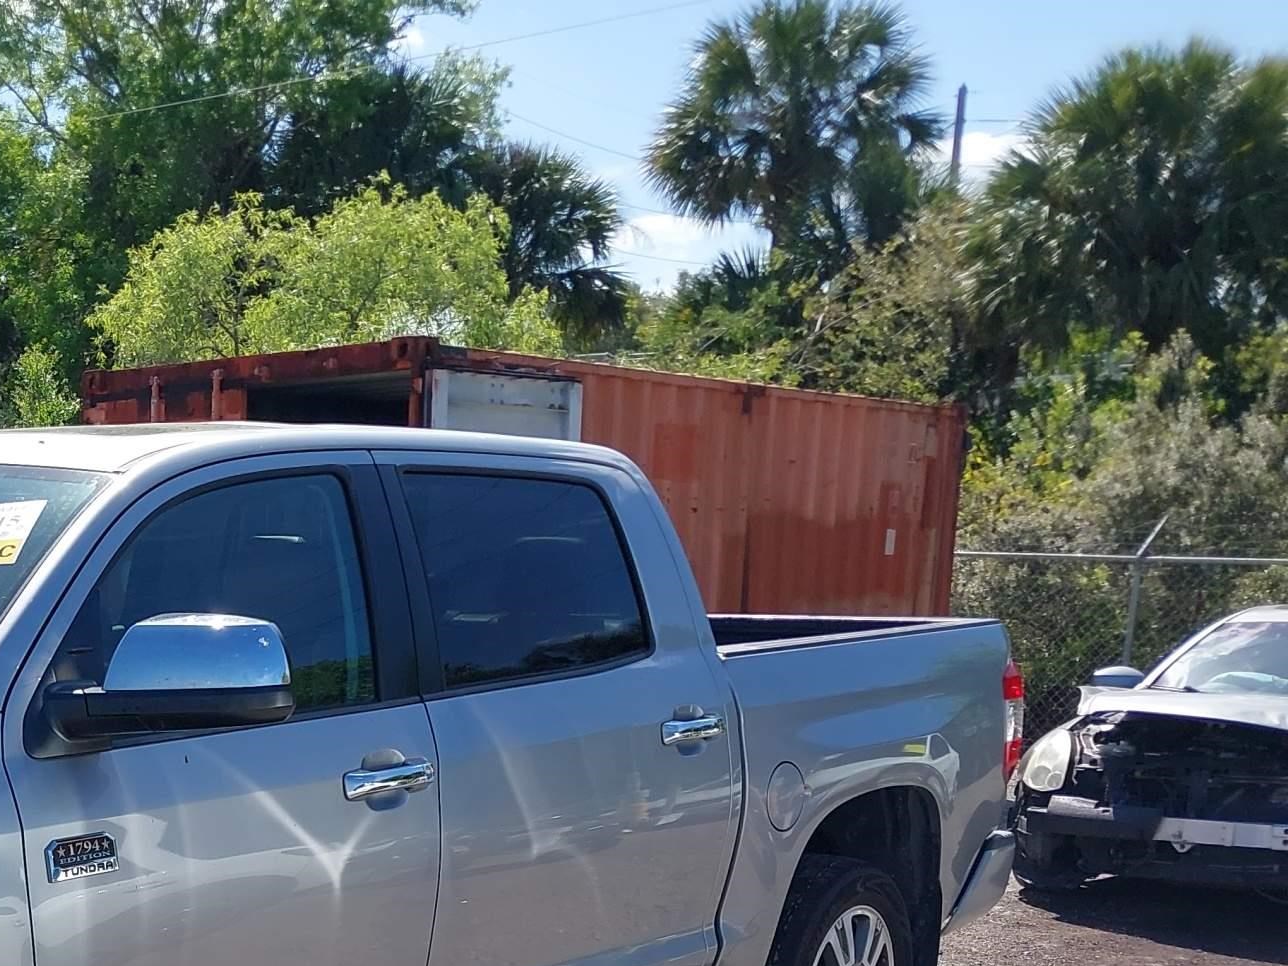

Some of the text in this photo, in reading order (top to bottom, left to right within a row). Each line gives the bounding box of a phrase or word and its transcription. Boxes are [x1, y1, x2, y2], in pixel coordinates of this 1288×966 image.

[67, 839, 101, 857] 1794
[58, 850, 112, 865] EDITION
[60, 860, 114, 878] TUNDRA
